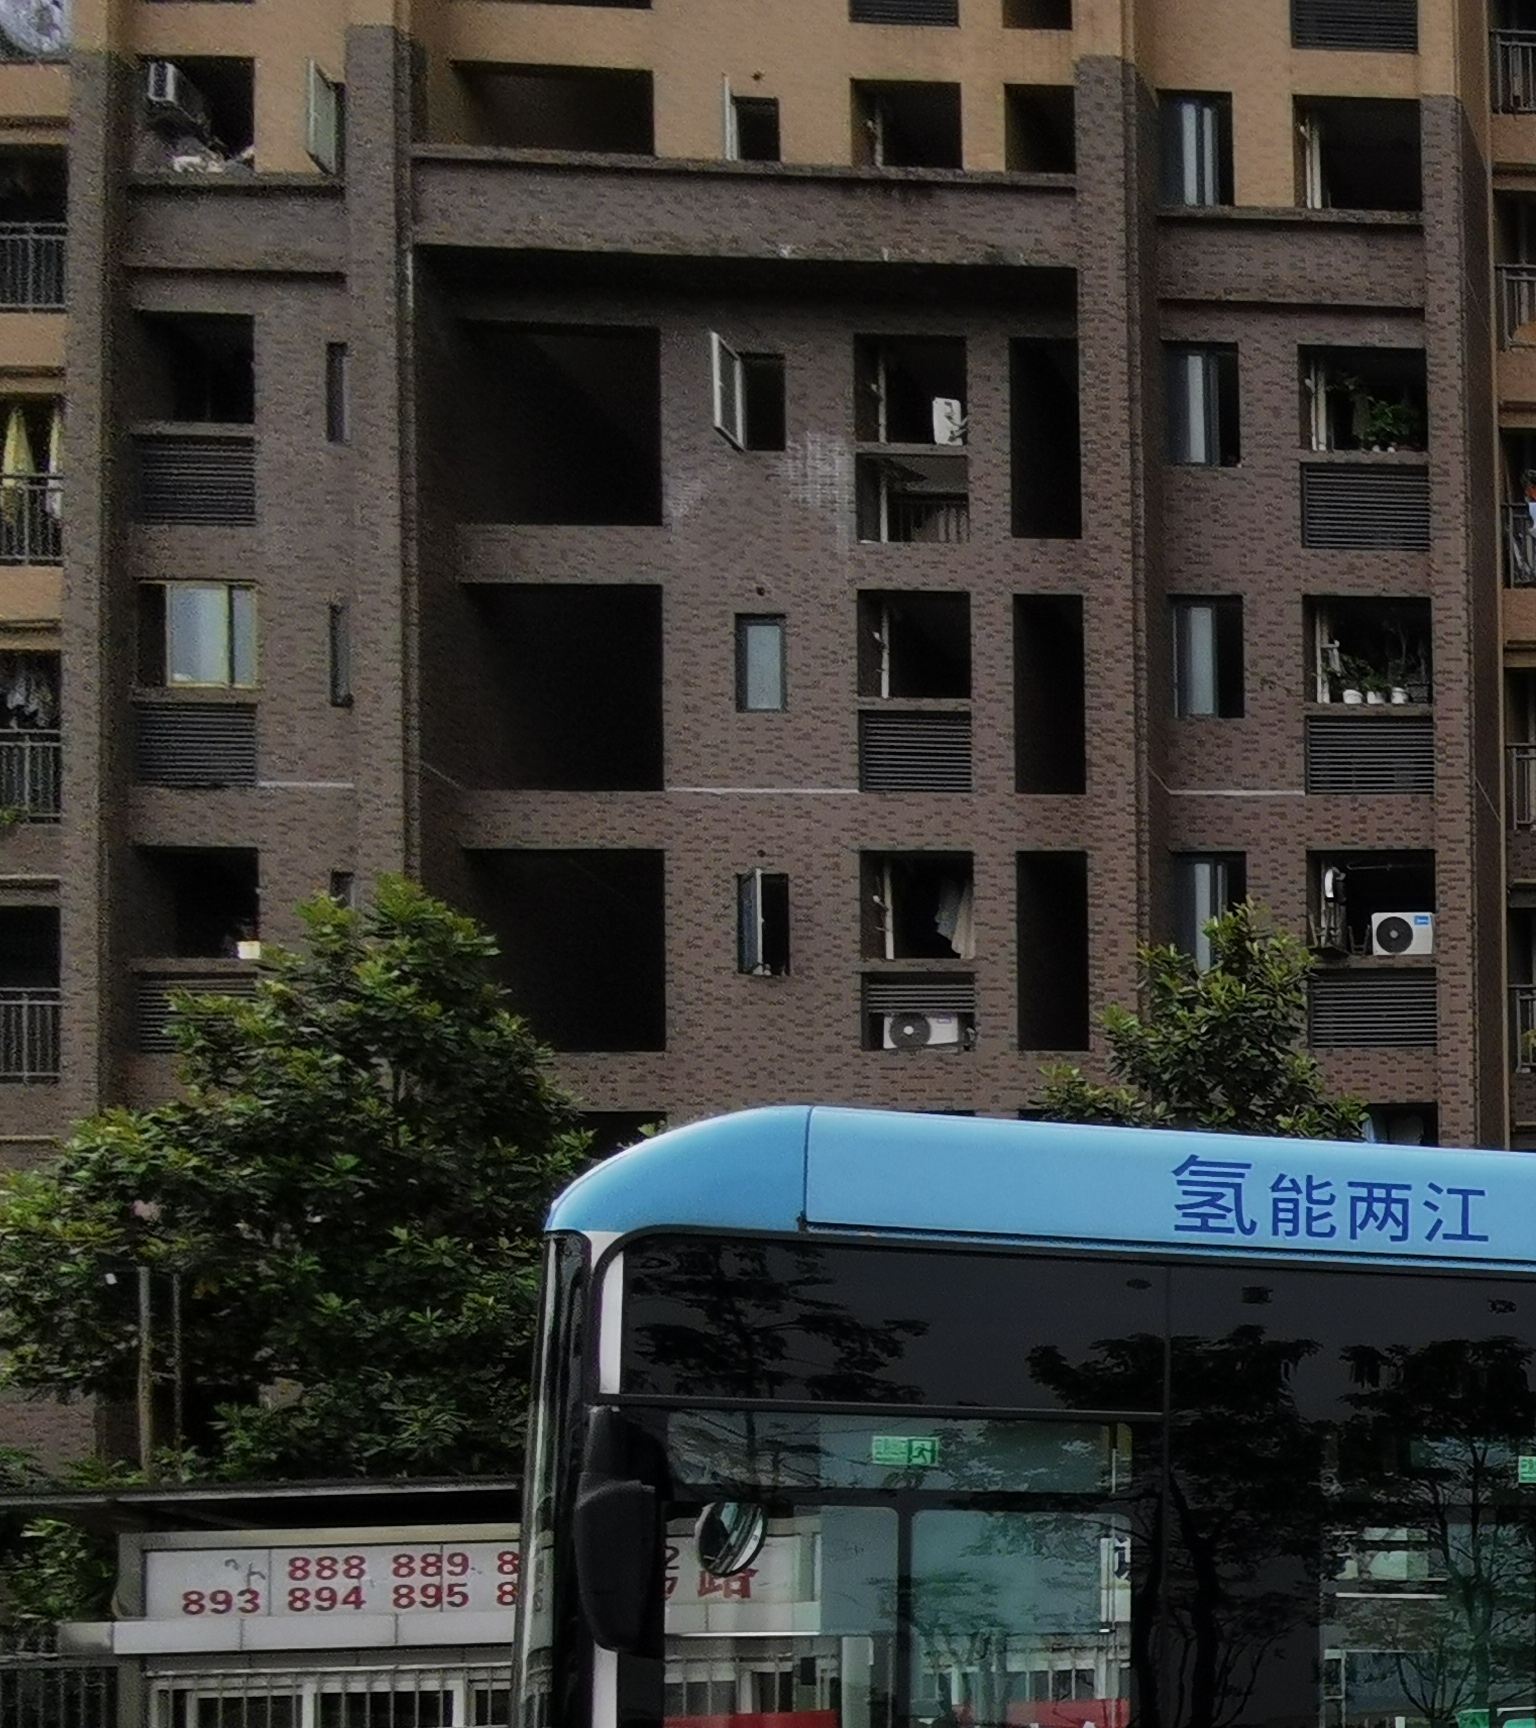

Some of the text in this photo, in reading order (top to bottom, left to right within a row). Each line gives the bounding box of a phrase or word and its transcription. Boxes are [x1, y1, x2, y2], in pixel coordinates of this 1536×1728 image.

[1171, 1154, 1490, 1243] 氢能两江
[287, 1555, 366, 1581] 888
[392, 1553, 470, 1578] 889
[182, 1589, 260, 1616] 893
[287, 1586, 366, 1612] 894
[392, 1582, 469, 1609] 895
